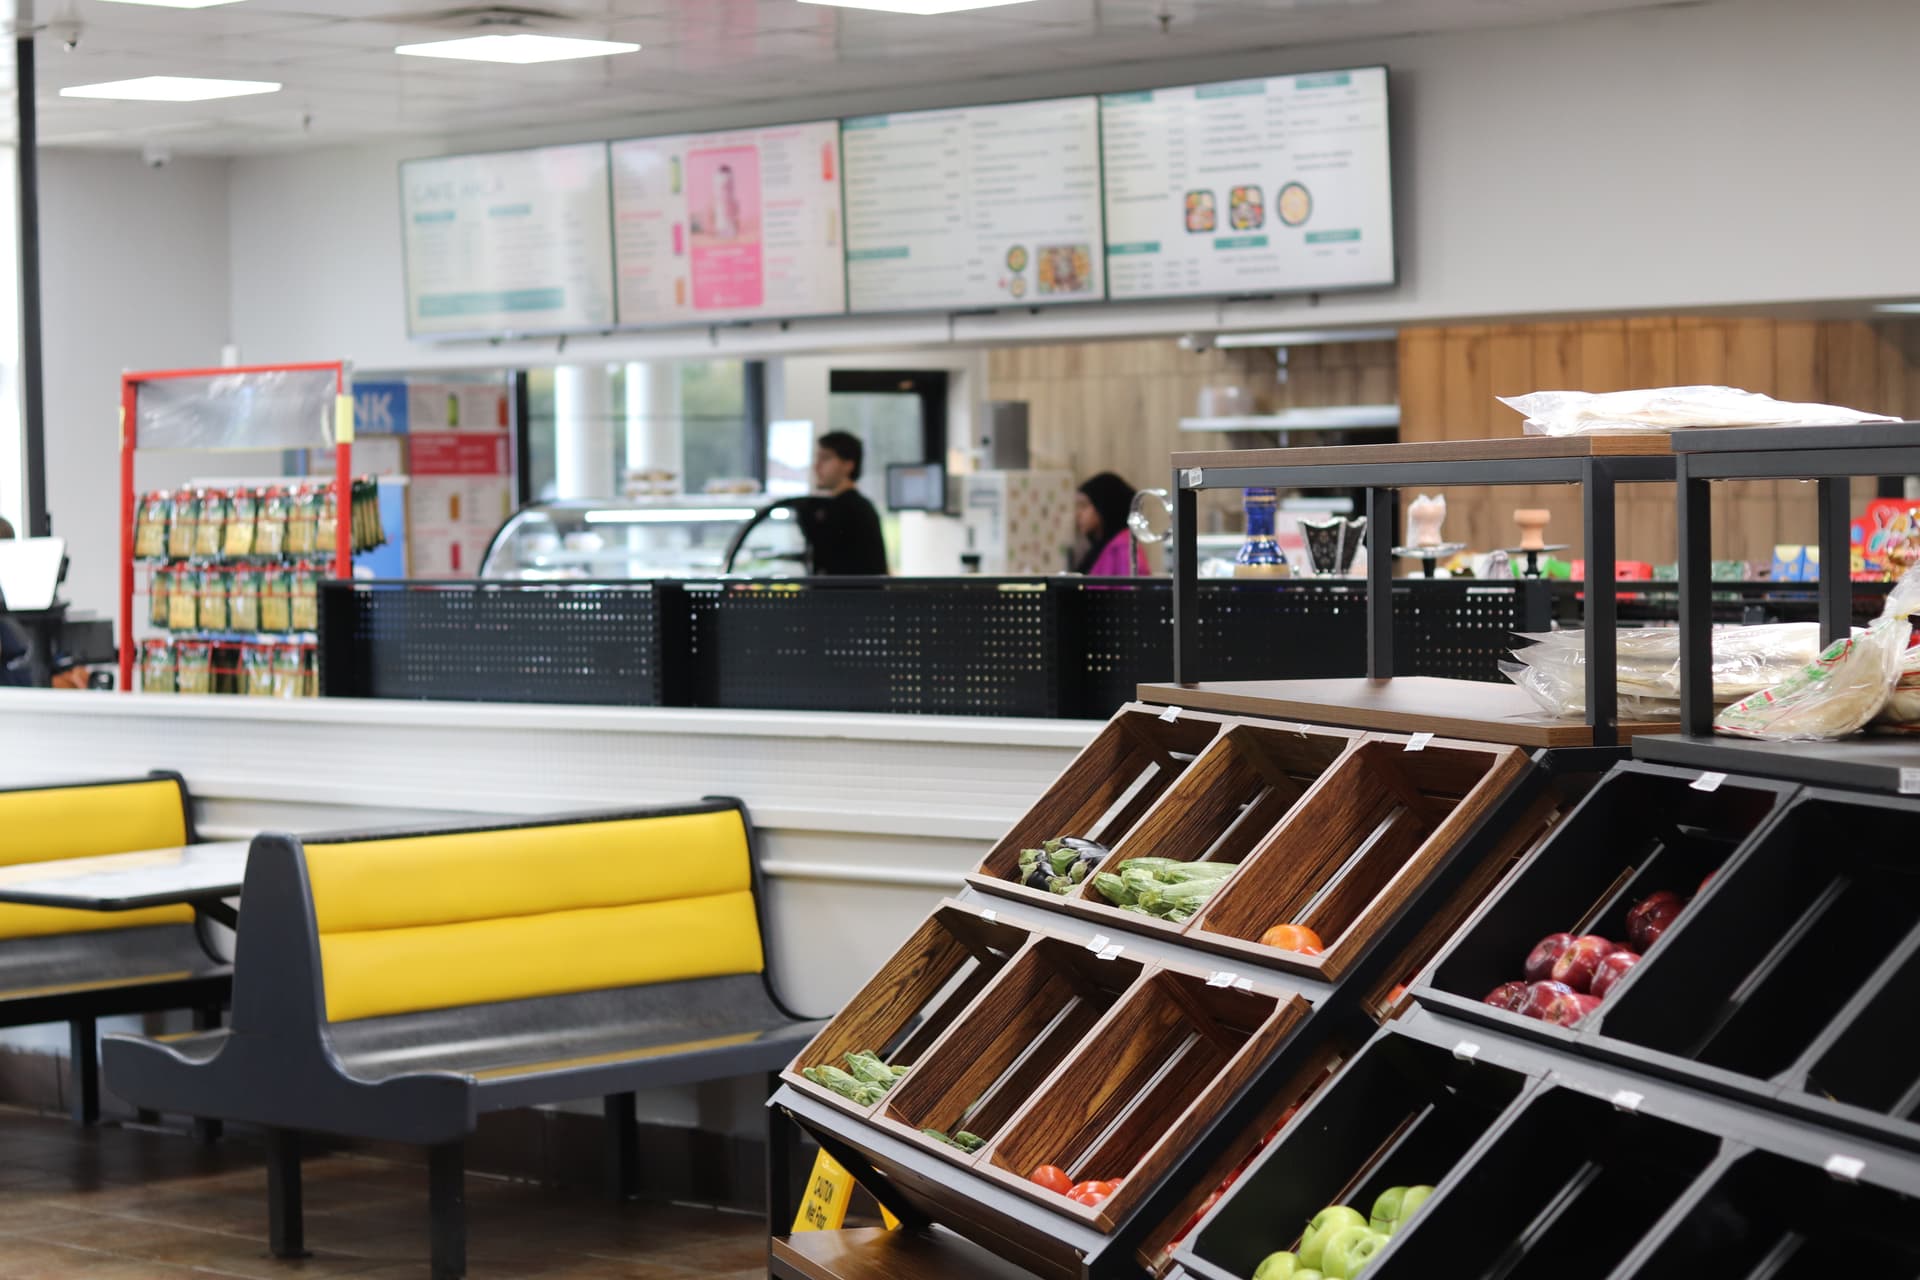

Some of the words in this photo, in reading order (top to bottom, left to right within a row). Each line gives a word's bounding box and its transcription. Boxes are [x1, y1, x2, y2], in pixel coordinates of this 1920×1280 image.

[814, 1176, 834, 1204] CAUTION
[805, 1200, 816, 1224] Wet
[816, 1205, 828, 1231] Floor
